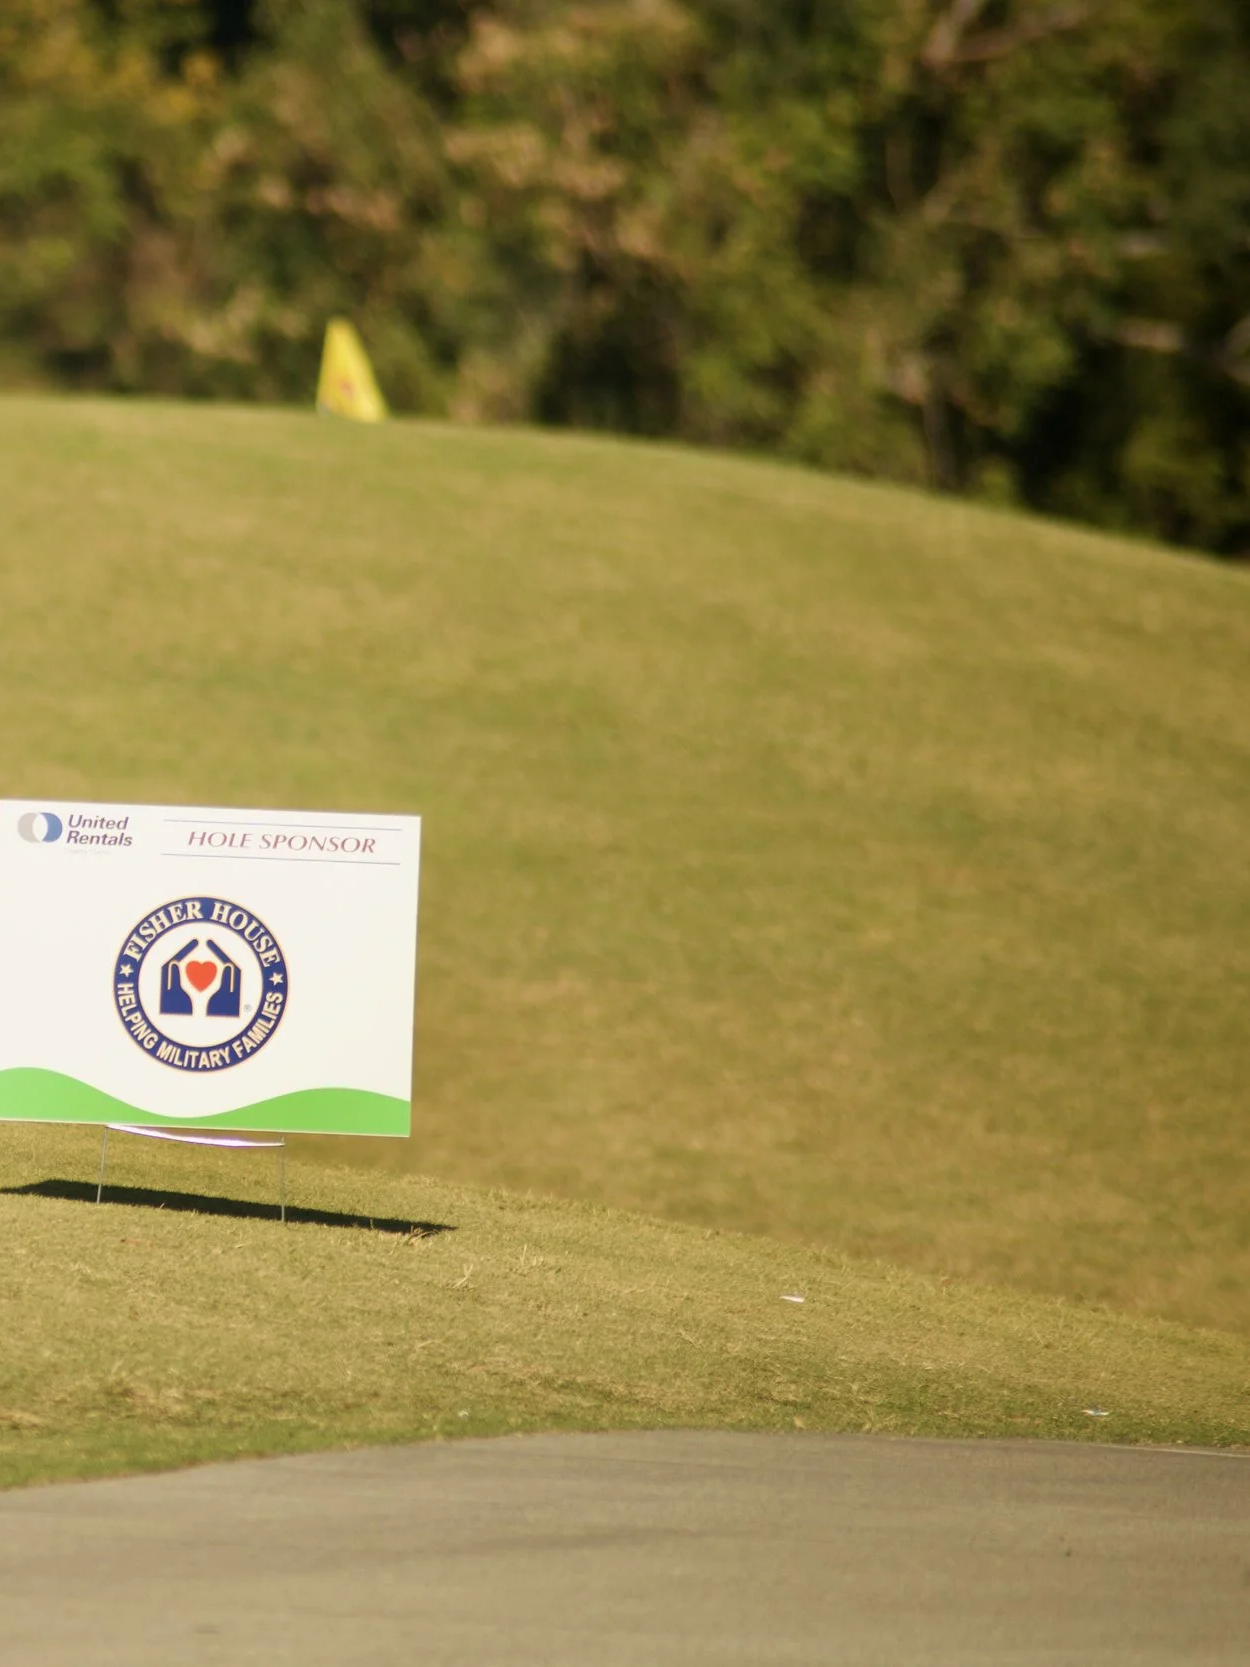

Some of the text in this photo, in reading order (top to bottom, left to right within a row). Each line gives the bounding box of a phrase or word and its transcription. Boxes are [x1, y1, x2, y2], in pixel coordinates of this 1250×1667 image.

[67, 814, 129, 831] United
[66, 830, 133, 848] Rentals
[188, 831, 377, 854] HOLE SPONSOR
[123, 901, 281, 968] FISHER HOUSE
[117, 982, 284, 1069] HELPING MILITARY FAMILIES
